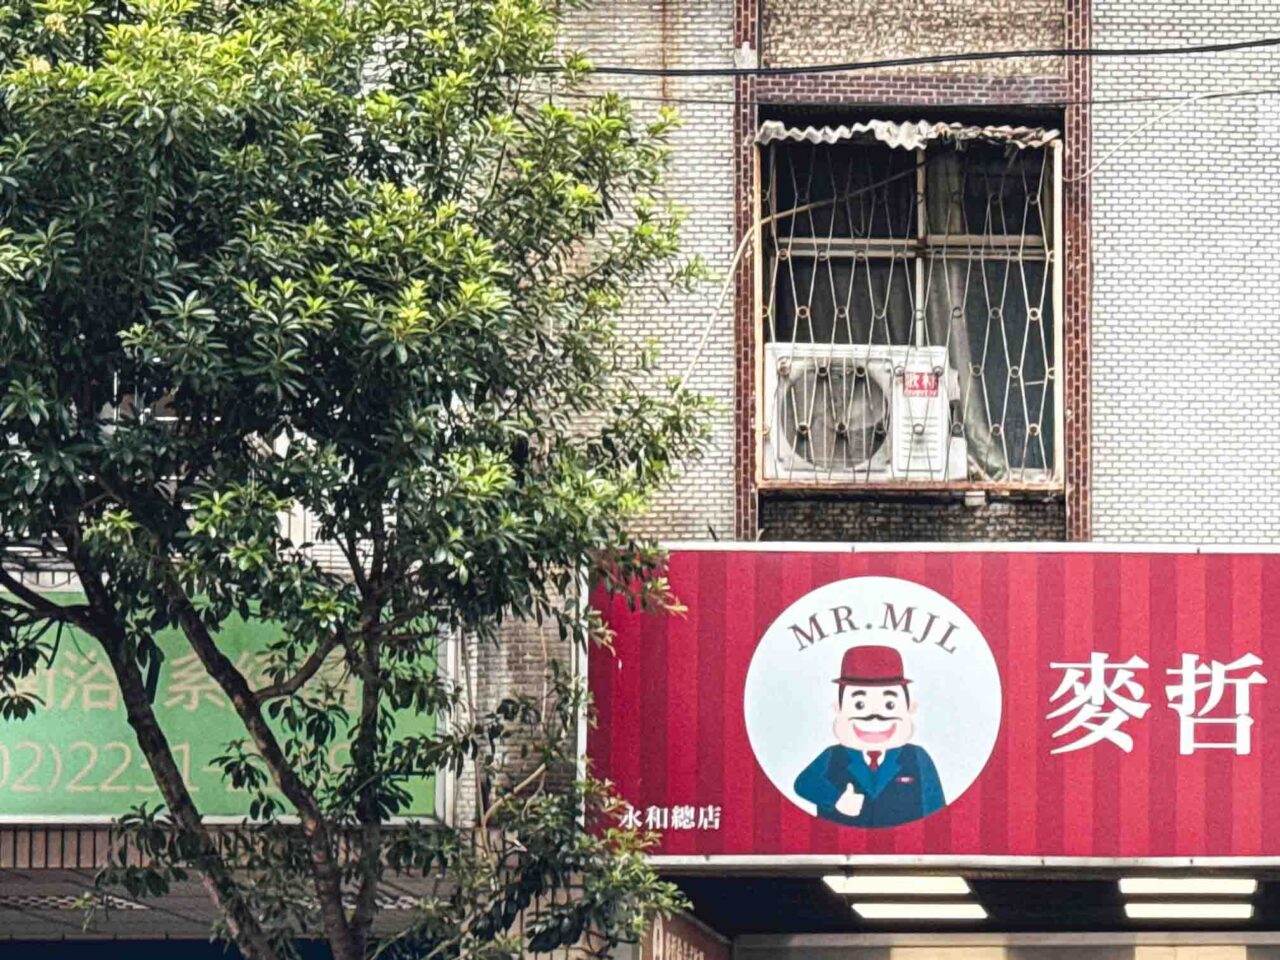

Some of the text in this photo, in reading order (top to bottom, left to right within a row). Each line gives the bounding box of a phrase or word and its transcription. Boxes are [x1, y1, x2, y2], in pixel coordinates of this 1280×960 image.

[787, 602, 961, 655] MR.MJL
[618, 804, 722, 830] 永和總店
